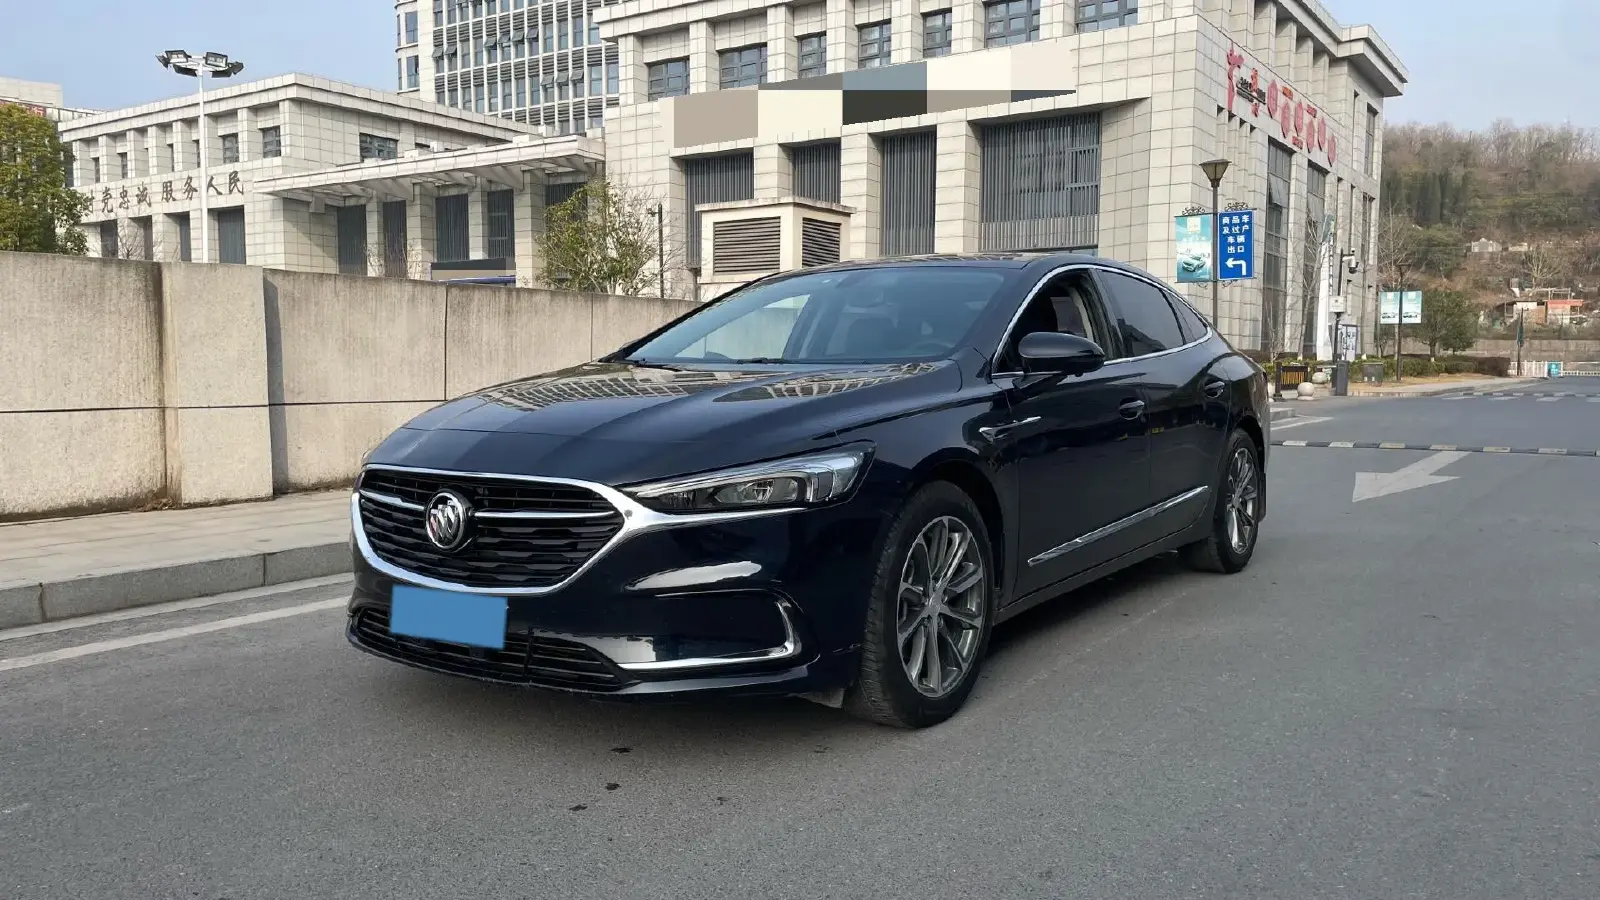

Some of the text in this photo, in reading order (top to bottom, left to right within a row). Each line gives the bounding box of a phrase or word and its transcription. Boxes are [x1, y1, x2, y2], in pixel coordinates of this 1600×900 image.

[161, 170, 244, 203] 服务人民
[1222, 214, 1250, 225] 商品车
[1222, 225, 1249, 234] 及过户
[1227, 235, 1246, 244] 车辆
[1227, 245, 1245, 254] 出口
